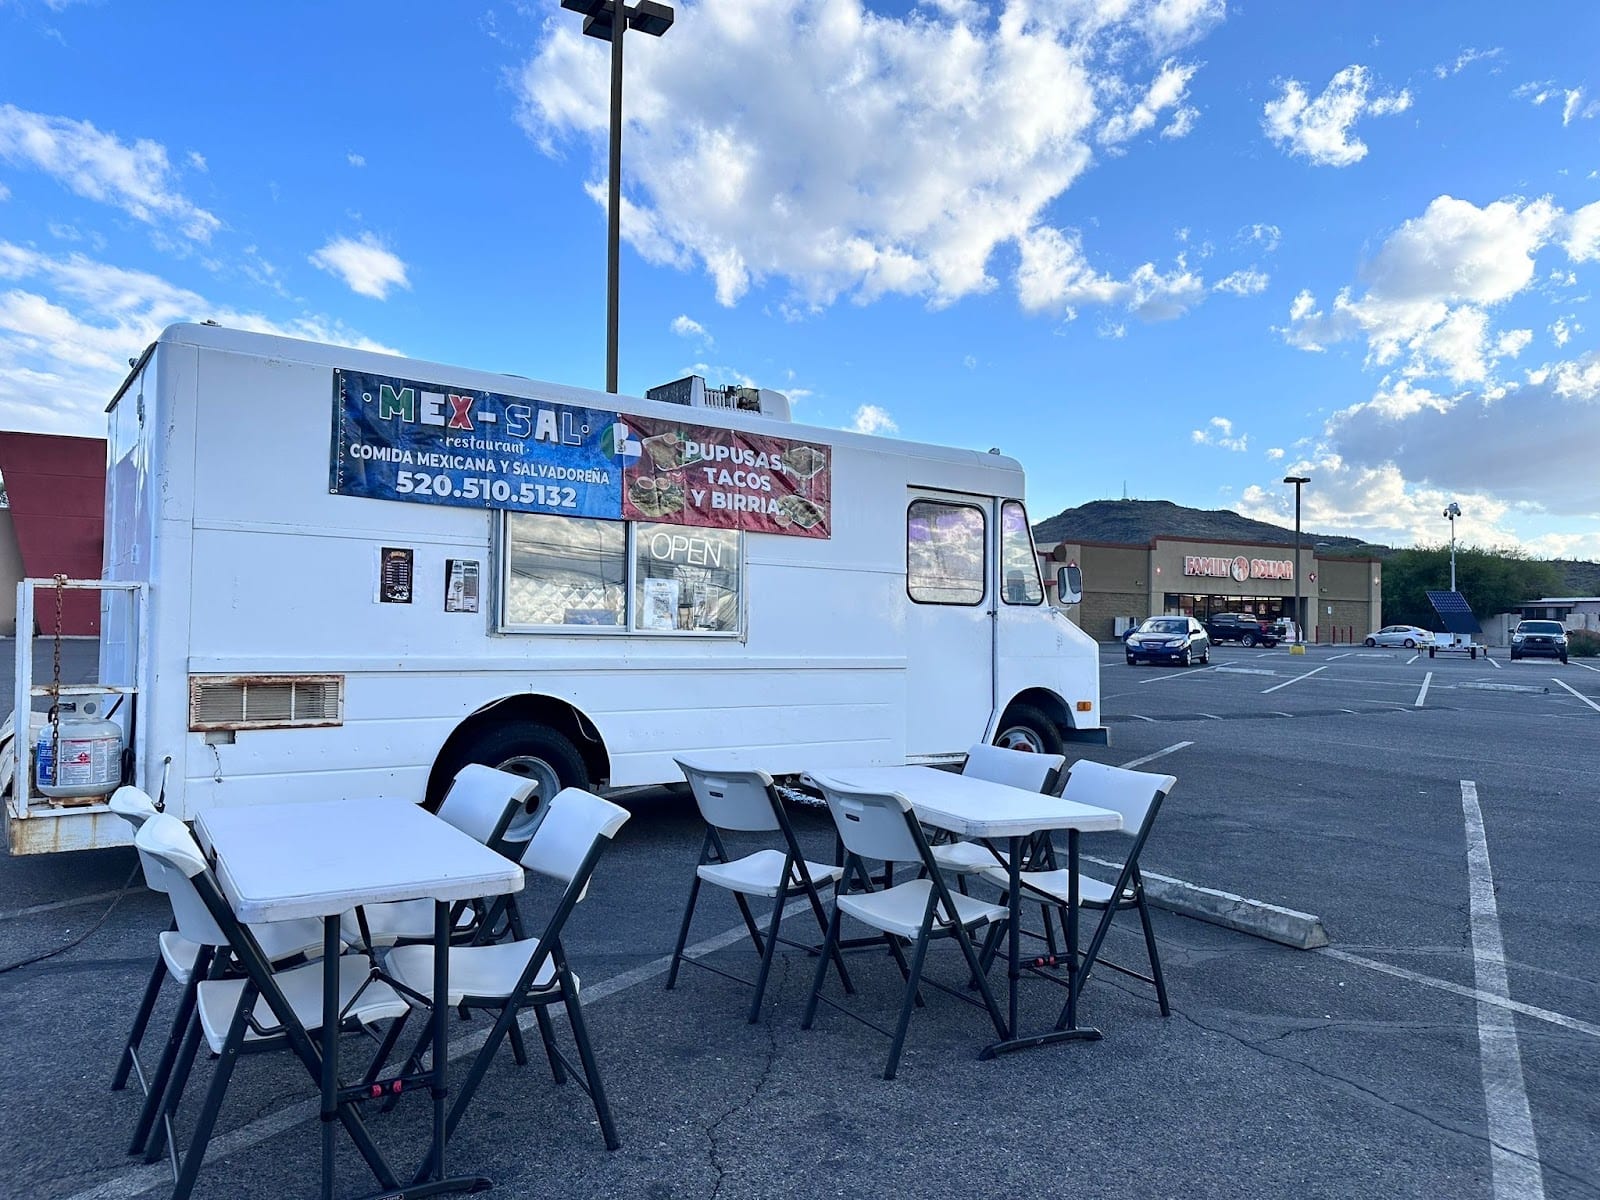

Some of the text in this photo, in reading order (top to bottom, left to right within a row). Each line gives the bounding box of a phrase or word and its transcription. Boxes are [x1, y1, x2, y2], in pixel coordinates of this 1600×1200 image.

[350, 443, 610, 485] COMIDA MEXICANA Y SALVADOREÑA
[395, 471, 577, 508] 520.510.5132
[704, 468, 771, 491] TACOS
[691, 489, 705, 507] Y
[651, 533, 722, 567] OPEN
[1185, 556, 1233, 577] FAMILY
